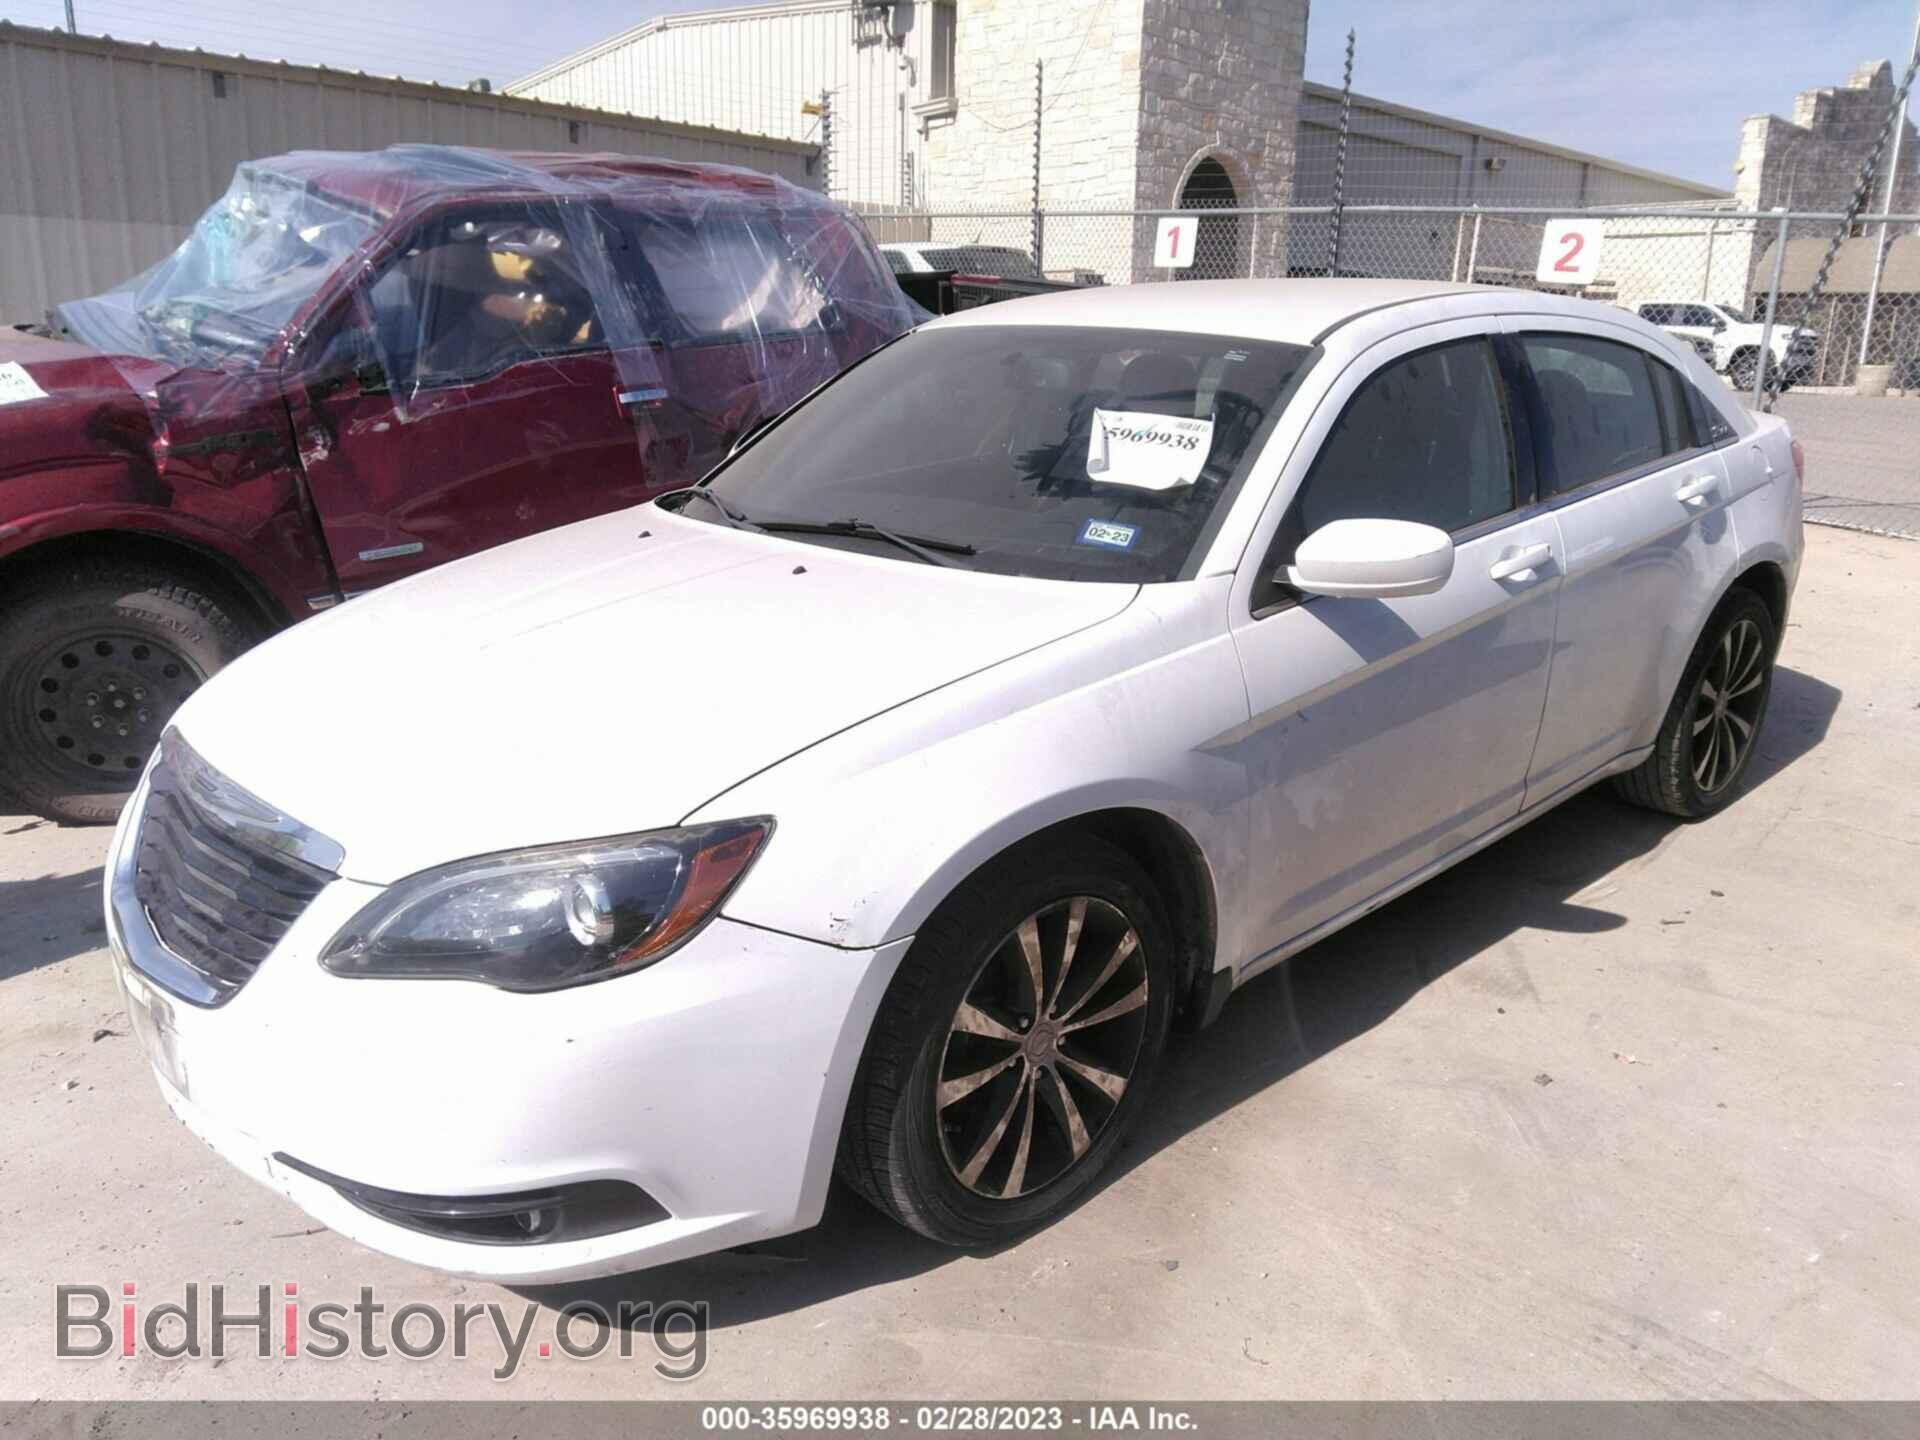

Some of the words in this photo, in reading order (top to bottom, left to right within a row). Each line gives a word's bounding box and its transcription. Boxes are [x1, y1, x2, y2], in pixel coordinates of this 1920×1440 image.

[1167, 225, 1181, 258] 1
[1553, 231, 1585, 272] 2
[1103, 426, 1200, 450] 5969938
